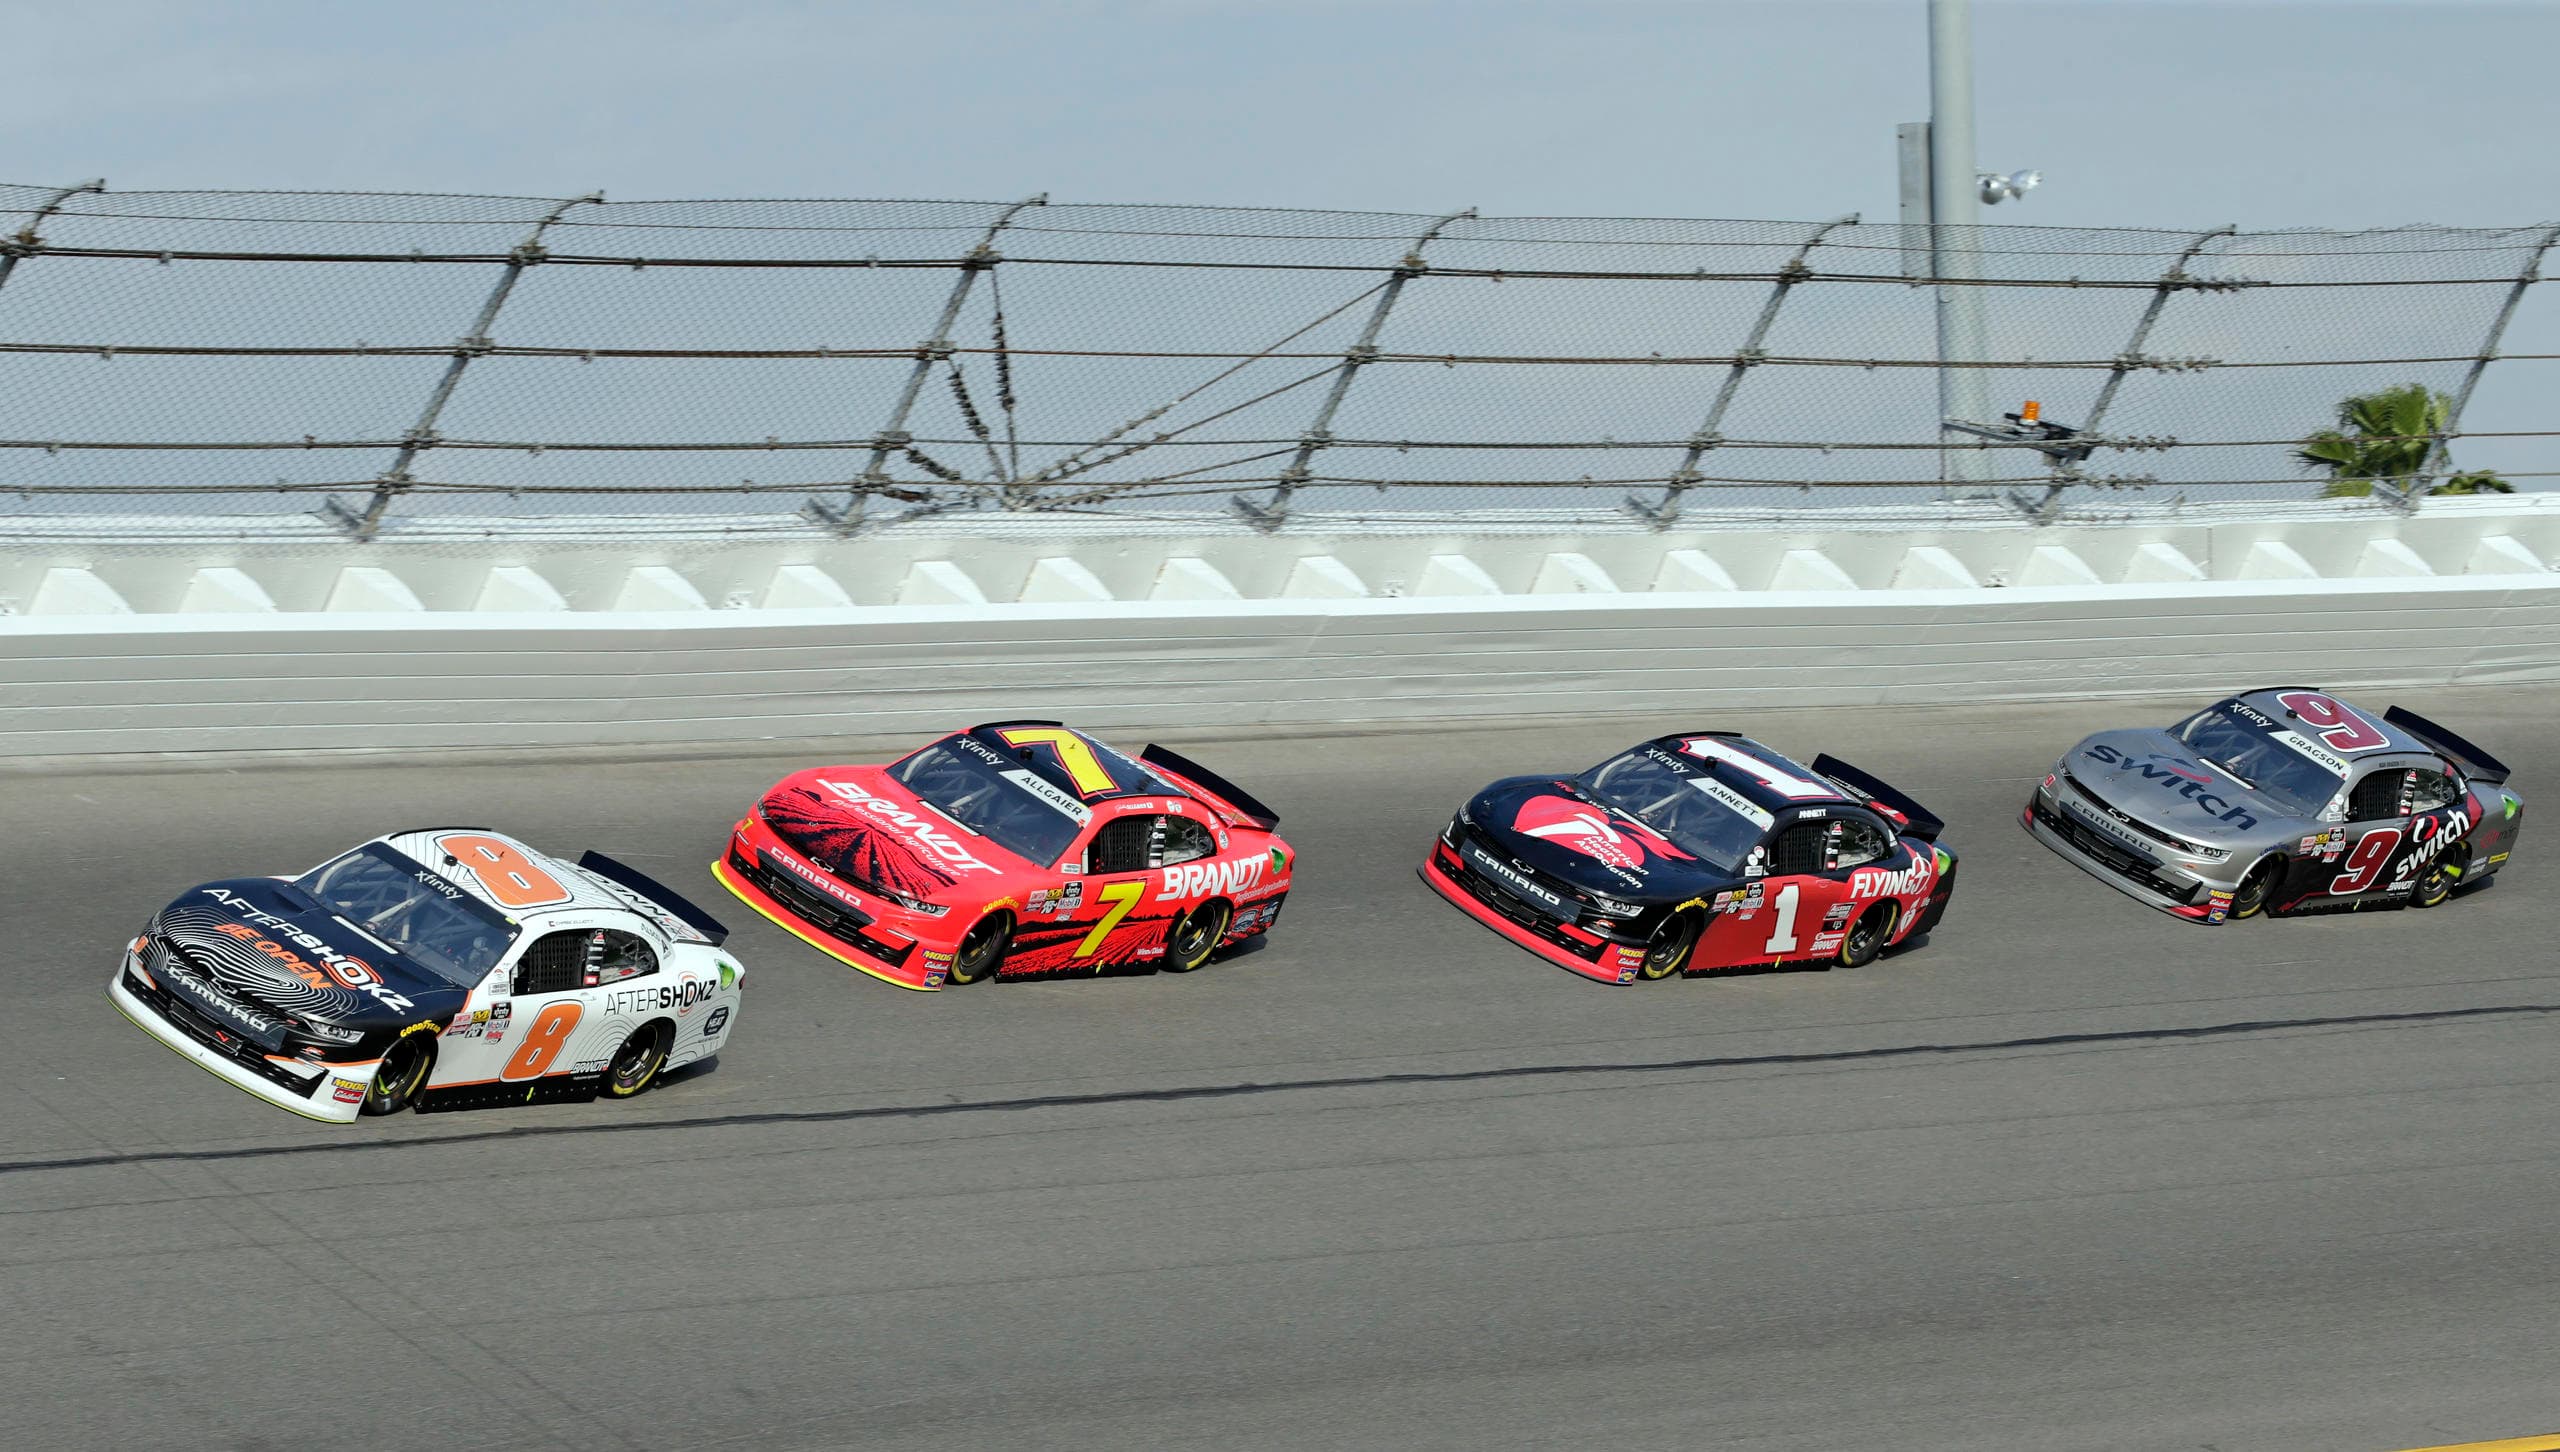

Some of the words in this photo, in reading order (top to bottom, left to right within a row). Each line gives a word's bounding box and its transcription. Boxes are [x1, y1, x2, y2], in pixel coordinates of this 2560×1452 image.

[2230, 702, 2272, 727] xfinity
[2276, 691, 2390, 752] 9
[957, 737, 1003, 765] xfinity
[998, 729, 1119, 797] 7
[1645, 748, 1690, 775] xfinity
[1682, 738, 1840, 799] 1
[2289, 735, 2344, 771] GRAGSON
[1022, 774, 1083, 816] ALLGAIER
[1708, 785, 1759, 817] ANNETT
[742, 818, 753, 832] 7
[816, 779, 1004, 875] BRANDT
[830, 799, 901, 835] Professional
[900, 832, 961, 876] Agriculture
[2071, 800, 2152, 852] CAMARO
[435, 833, 573, 909] 8
[1573, 840, 1643, 888] Association
[1584, 837, 1619, 864] Heart
[1592, 835, 1649, 876] American
[2329, 827, 2402, 895] 9
[414, 870, 464, 900] xfinity
[770, 846, 861, 907] CAMARO
[1155, 852, 1269, 901] BRANDT
[1473, 849, 1560, 905] CAMARO
[1850, 868, 1915, 899] FLYING
[1072, 880, 1148, 960] 7
[1764, 883, 1800, 956] 1
[202, 888, 415, 1012] AFTERSHOKZ
[213, 923, 263, 941] BE
[255, 941, 333, 989] OPEN
[924, 950, 952, 961] MOOG
[1619, 947, 1645, 958] MOOG
[168, 966, 267, 1032] CAMARO
[604, 980, 716, 1016] AFTERSHOKZ
[400, 1019, 441, 1038] GOODYEAR
[500, 999, 585, 1083] 8
[334, 1078, 365, 1091] MOOG
